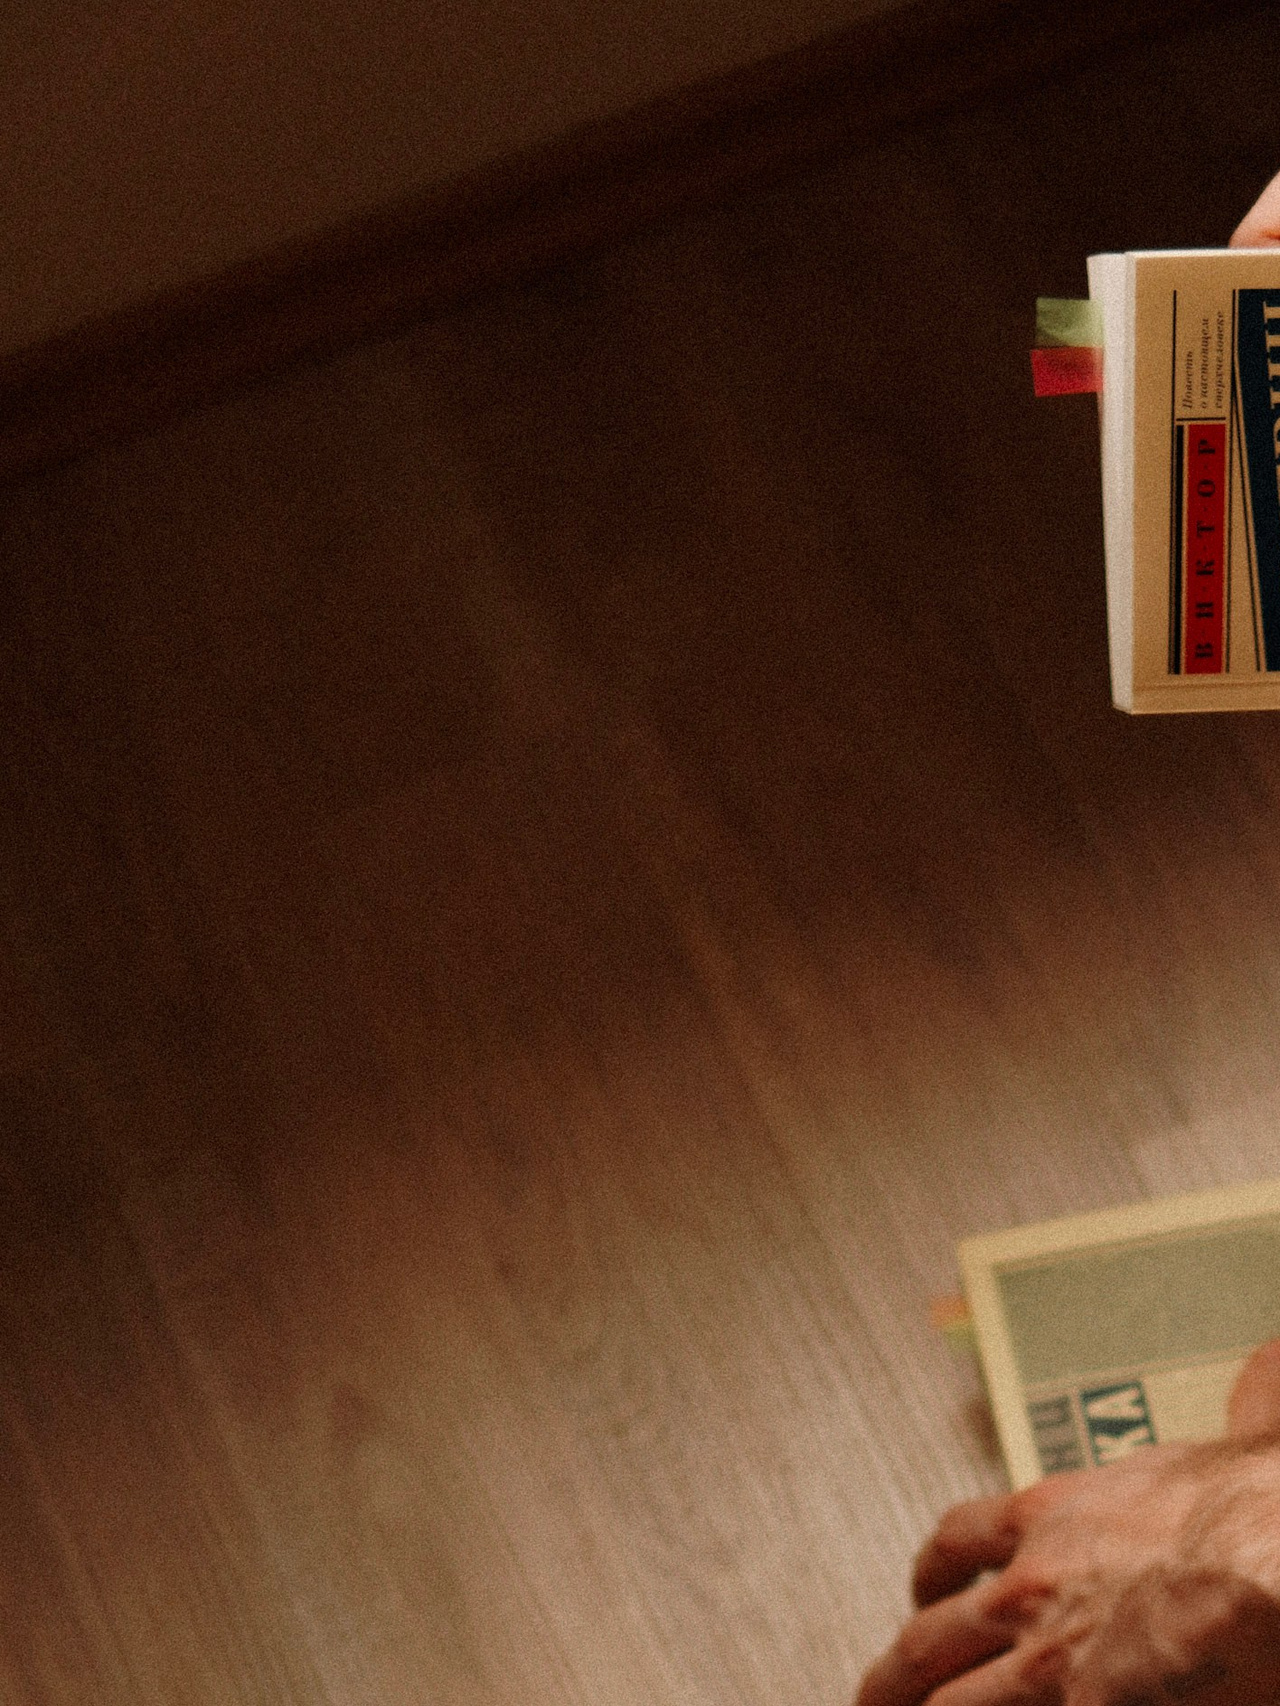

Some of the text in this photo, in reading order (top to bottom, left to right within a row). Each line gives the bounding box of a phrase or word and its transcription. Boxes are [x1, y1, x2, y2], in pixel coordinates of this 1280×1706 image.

[1182, 348, 1195, 410] Повесть
[1200, 316, 1213, 398] настоящем
[1213, 310, 1225, 410] сверхчеловеке
